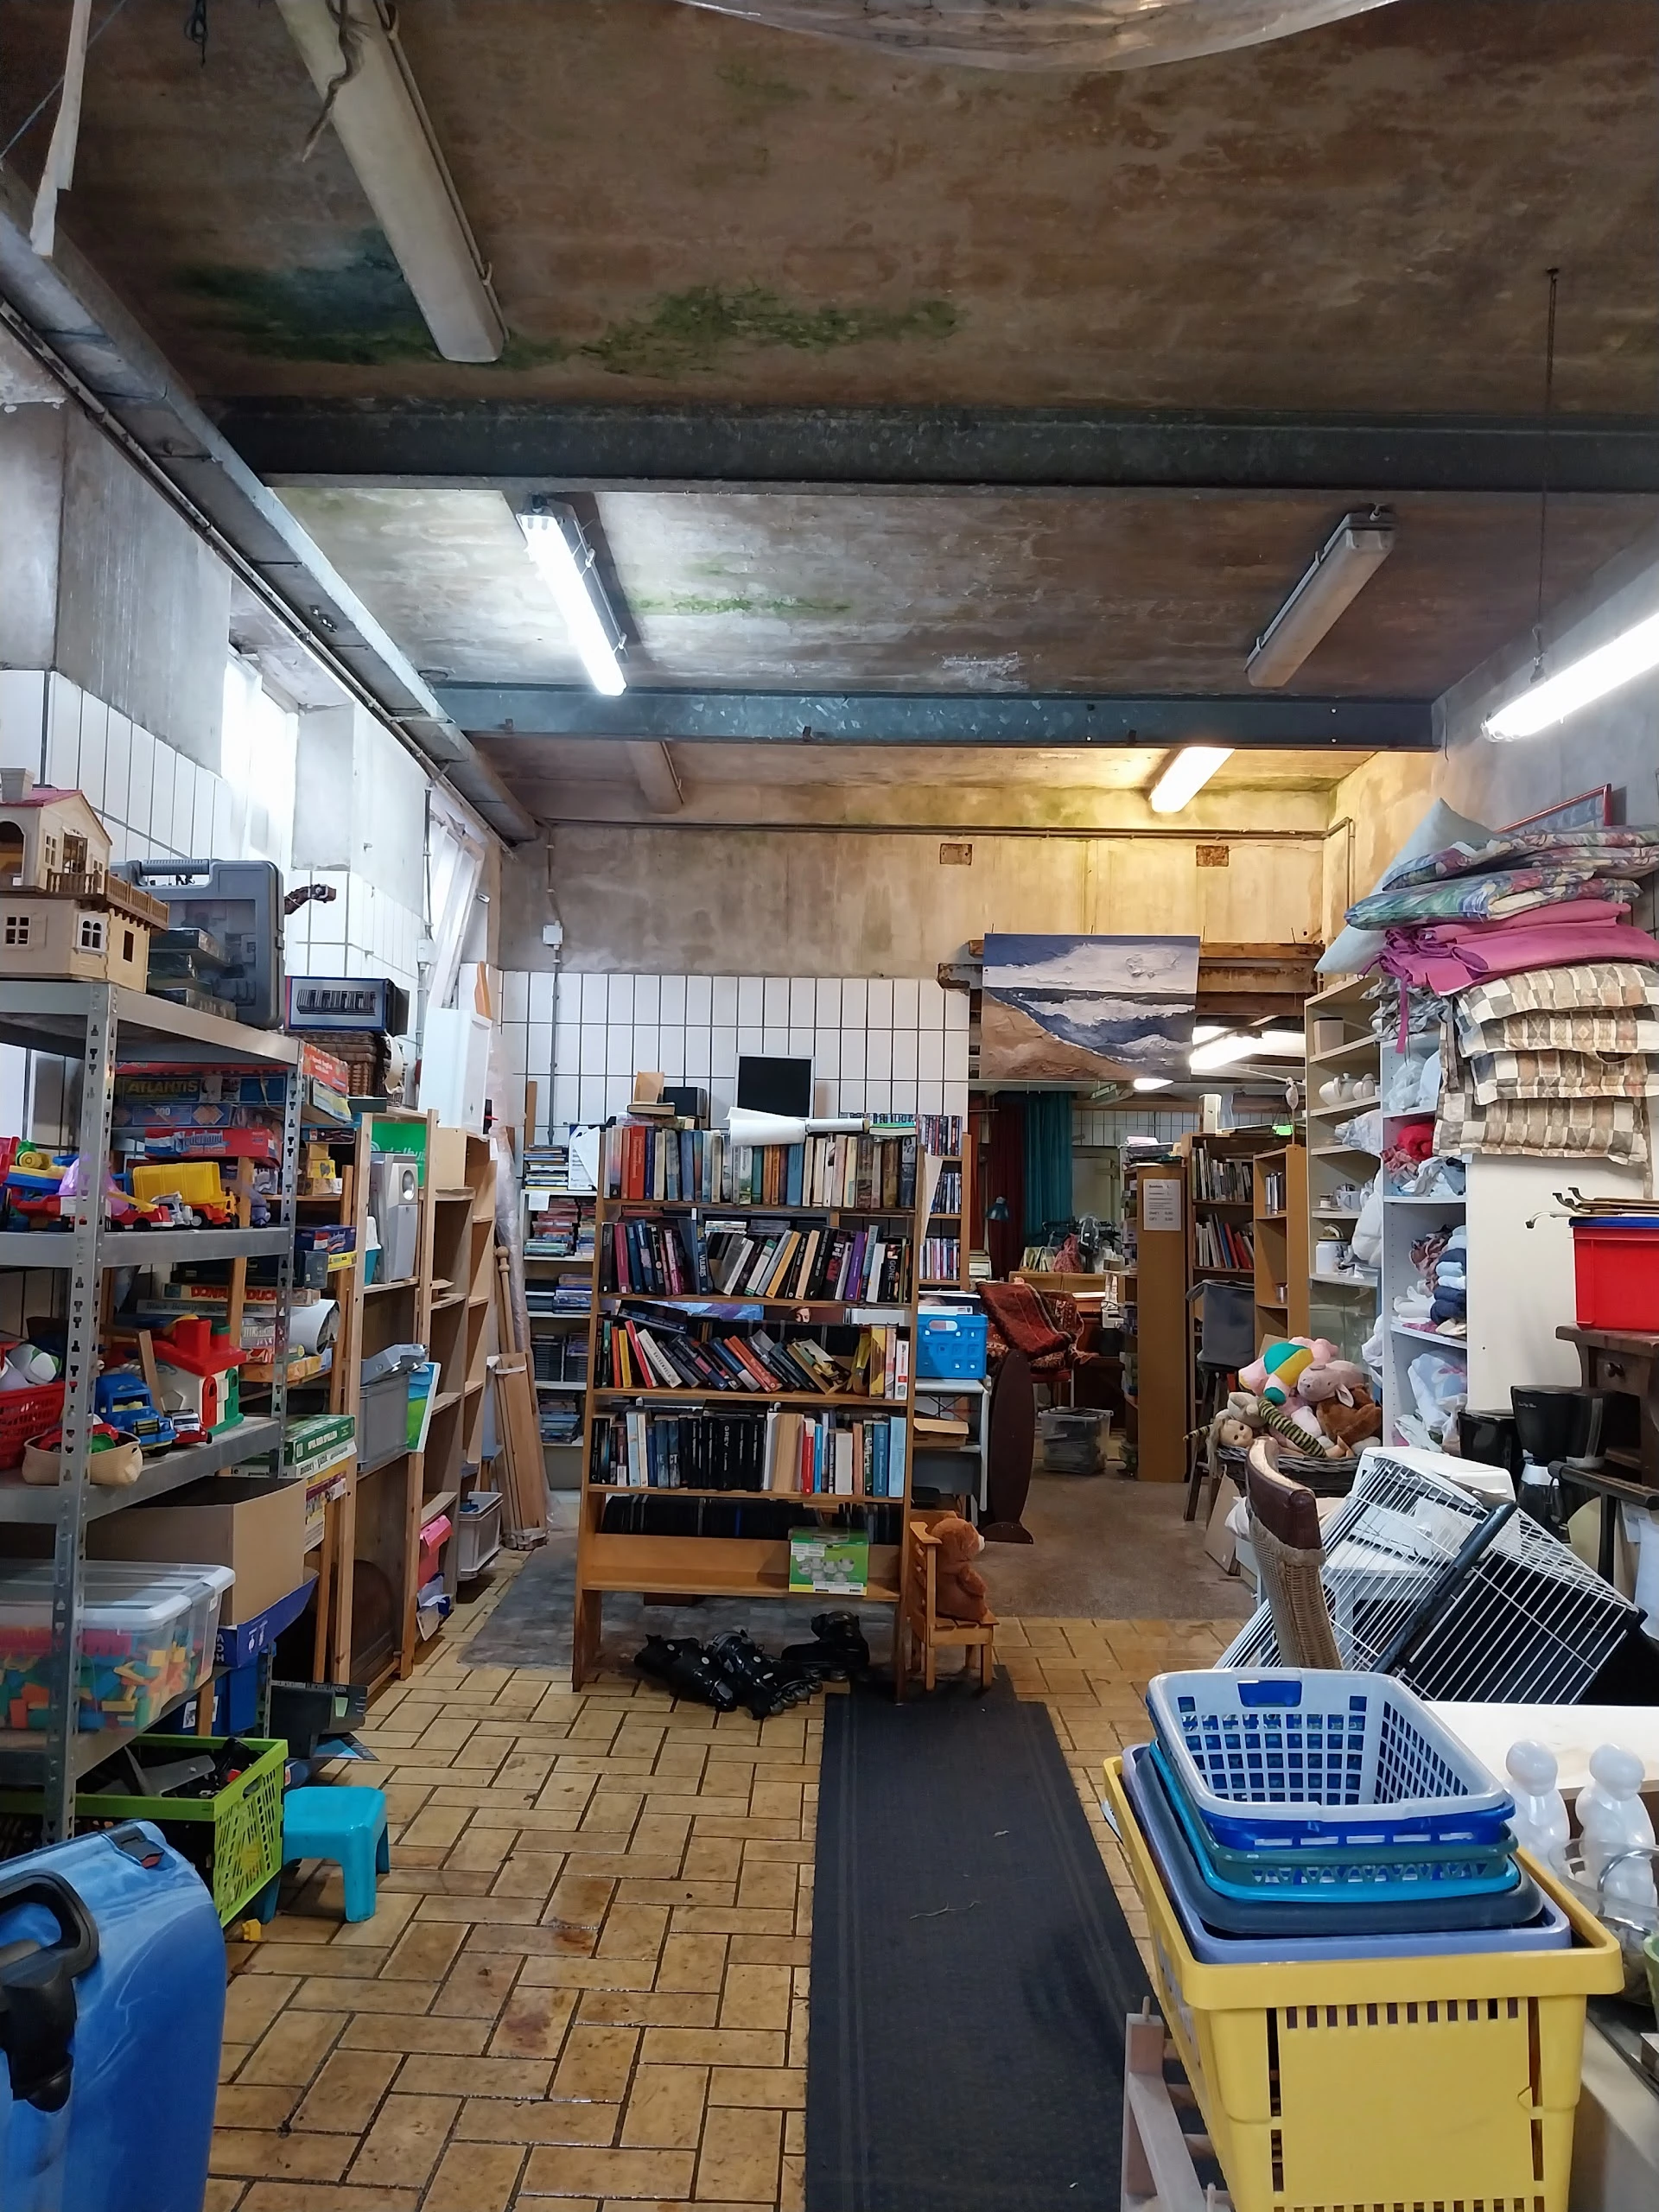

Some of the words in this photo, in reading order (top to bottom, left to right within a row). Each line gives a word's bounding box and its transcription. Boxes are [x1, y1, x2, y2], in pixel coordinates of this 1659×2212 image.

[126, 1080, 199, 1094] ATLANTIS
[174, 1129, 224, 1154] Nederland
[887, 1259, 897, 1281] GONE
